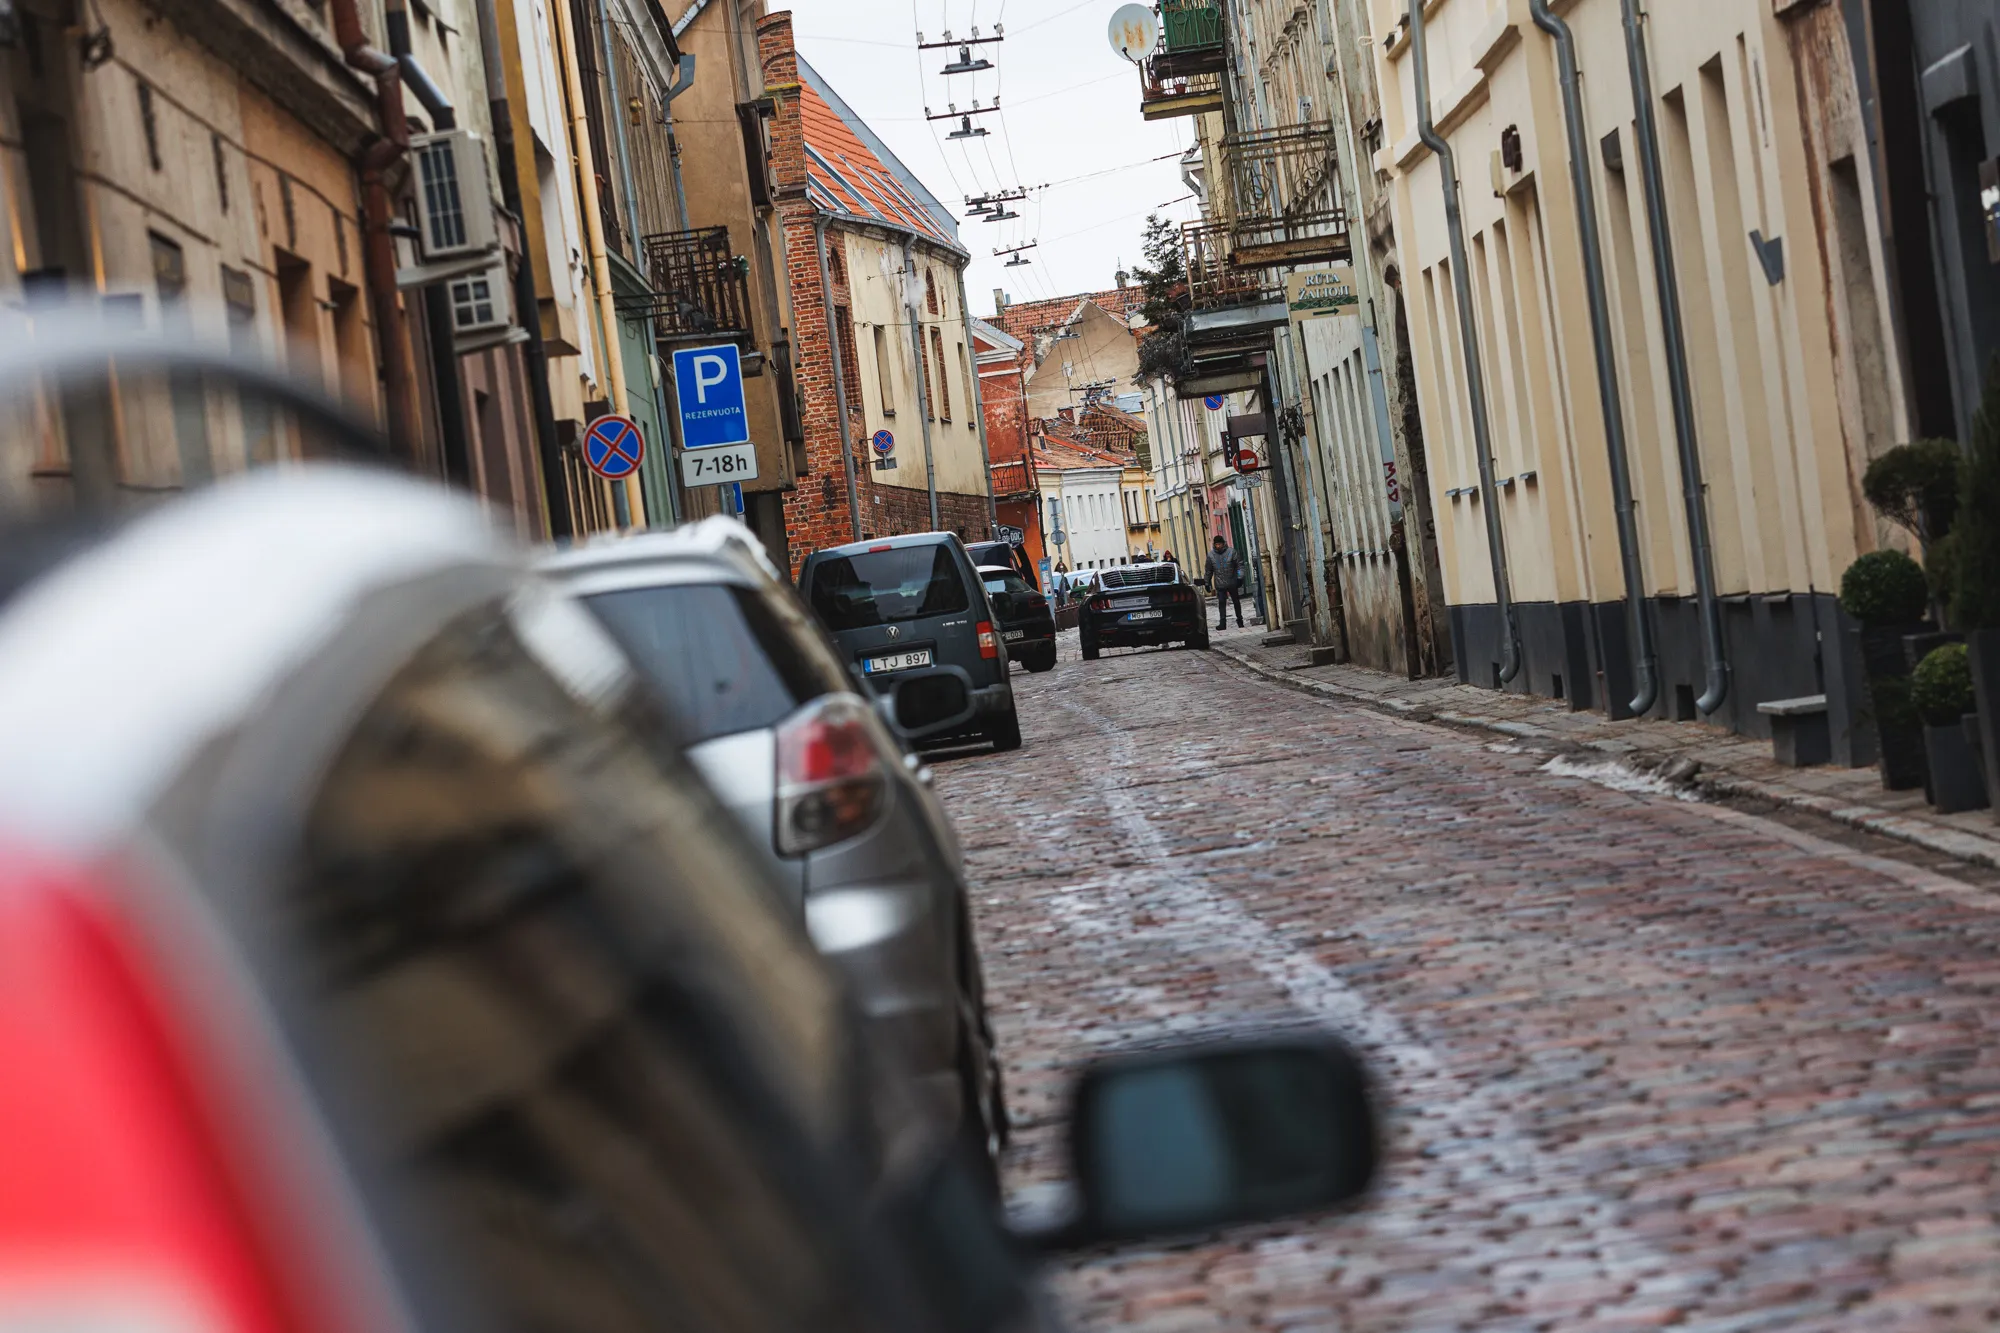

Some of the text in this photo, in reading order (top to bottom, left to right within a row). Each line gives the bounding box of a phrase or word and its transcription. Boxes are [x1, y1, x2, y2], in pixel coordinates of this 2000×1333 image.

[1305, 273, 1340, 286] RŪTA
[1298, 286, 1349, 300] ŽALIOJI
[693, 354, 728, 404] P
[685, 406, 741, 420] REZERVUOTA
[692, 454, 748, 477] 7-18h
[872, 652, 927, 671] LTJ 897
